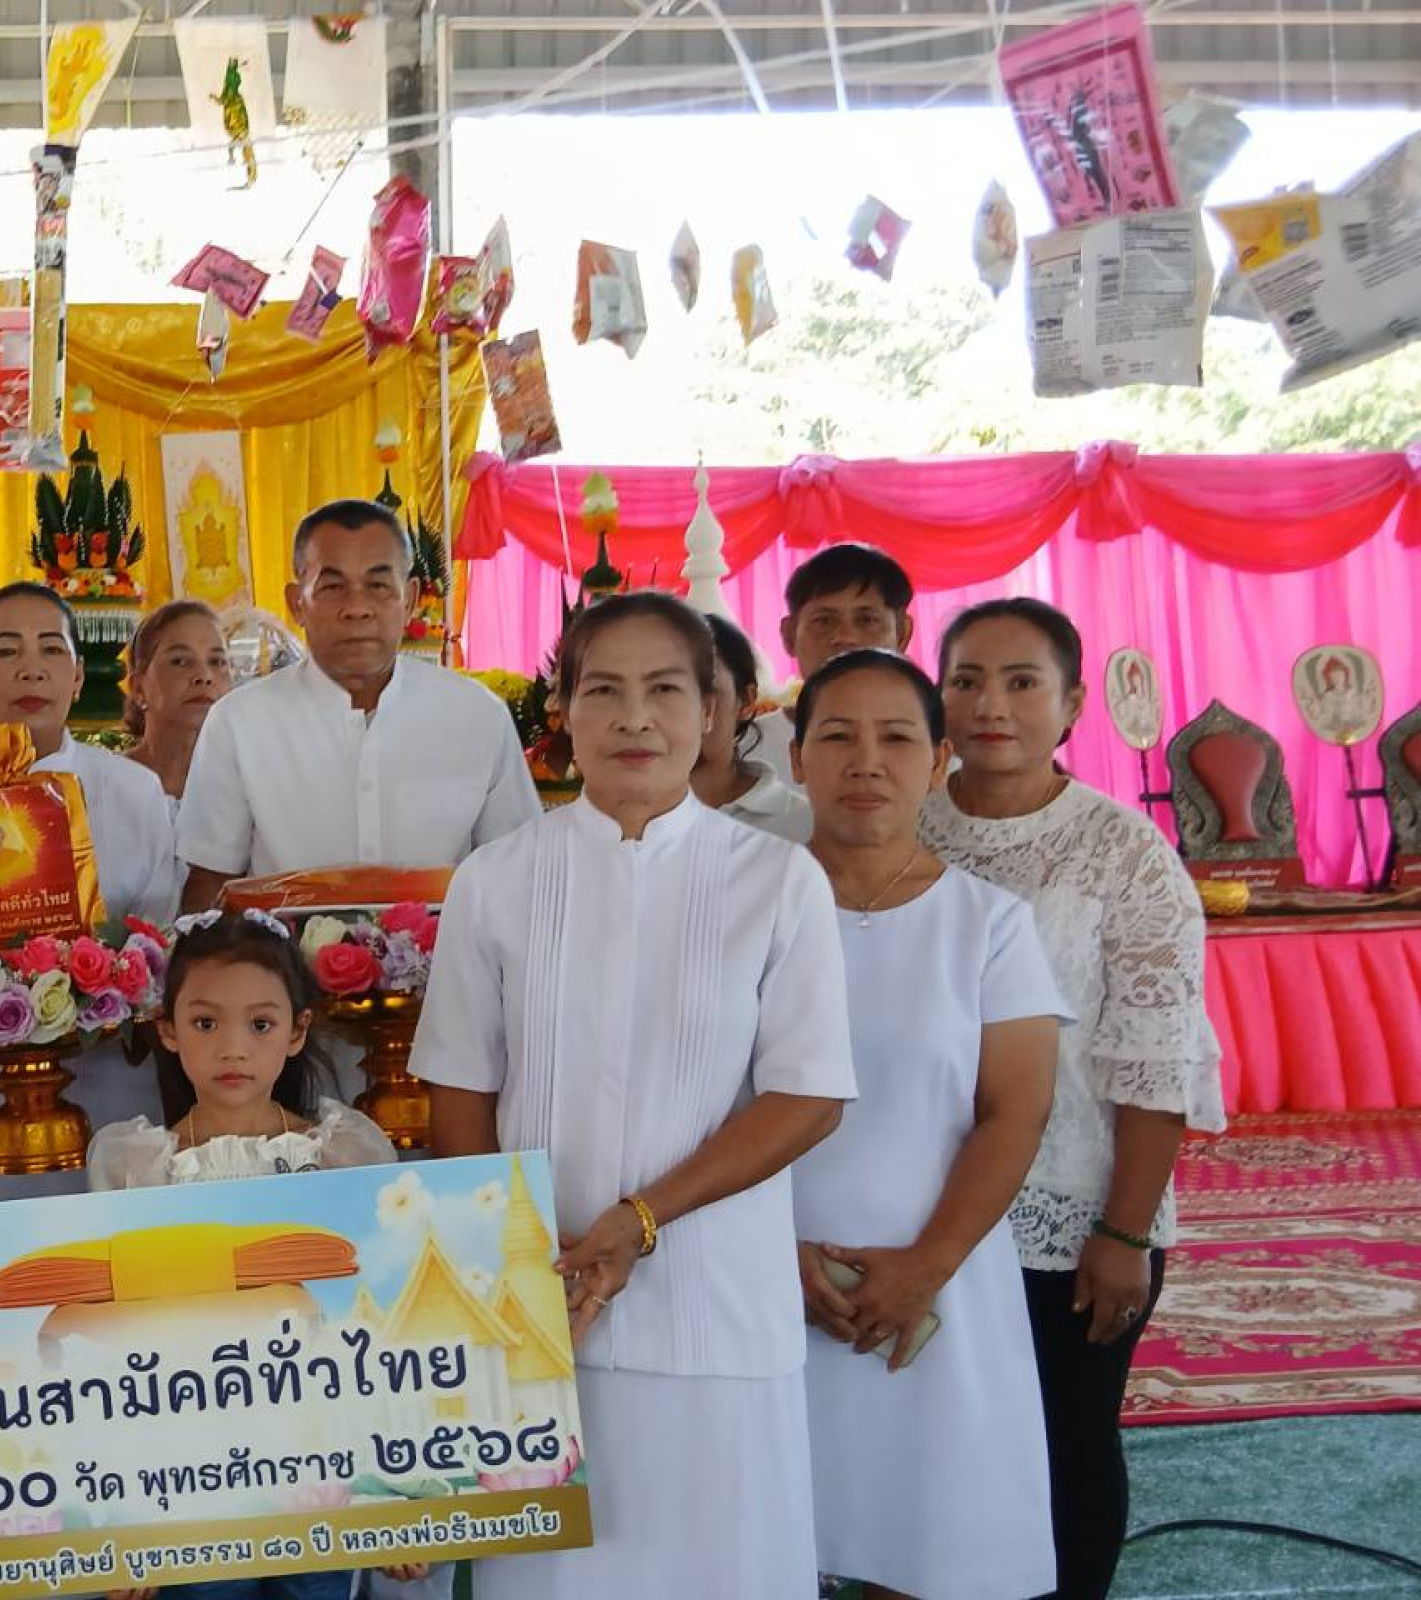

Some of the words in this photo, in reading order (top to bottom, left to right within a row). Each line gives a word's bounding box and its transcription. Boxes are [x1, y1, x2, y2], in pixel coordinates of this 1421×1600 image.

[75, 1461, 125, 1503] วัด
[137, 1447, 356, 1511] พุทธศักราช
[371, 1416, 560, 1475] ๒๕๖๘
[124, 1540, 253, 1579] บูชาธรรม
[263, 1538, 303, 1557] ๘๑
[310, 1524, 332, 1553] ปี
[342, 1506, 559, 1550] หลวงพ่อธัมมชโย
